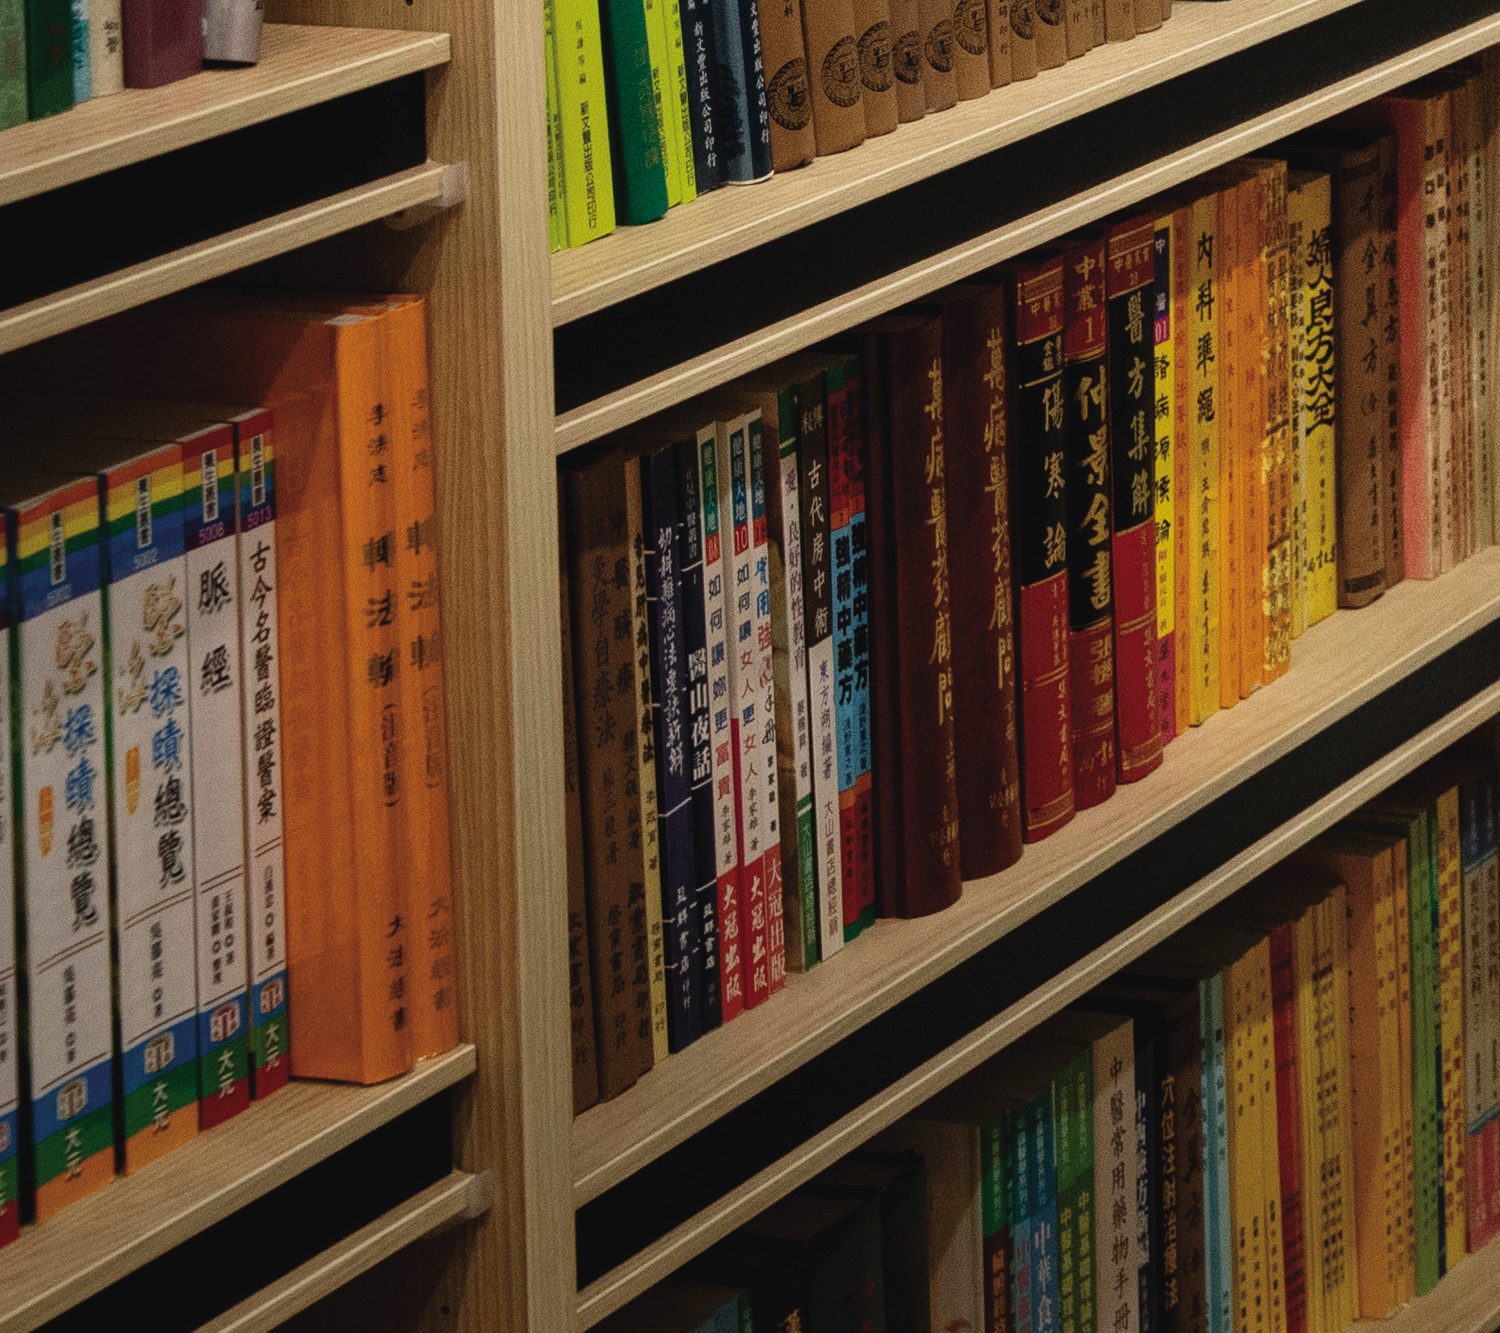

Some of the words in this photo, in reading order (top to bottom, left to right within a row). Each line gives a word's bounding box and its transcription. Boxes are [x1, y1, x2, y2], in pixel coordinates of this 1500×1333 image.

[1125, 294, 1152, 518] 醫方集解
[1195, 231, 1216, 425] 內科準繩
[1305, 228, 1336, 436] 婦人良方大全
[199, 560, 233, 694] 脈經
[808, 459, 829, 637] 古代房中術
[736, 562, 759, 783] 如何讓女人更女人
[722, 885, 742, 1003] 大冠出版
[749, 874, 768, 992] 大冠出版
[767, 857, 786, 985] 大冠出版
